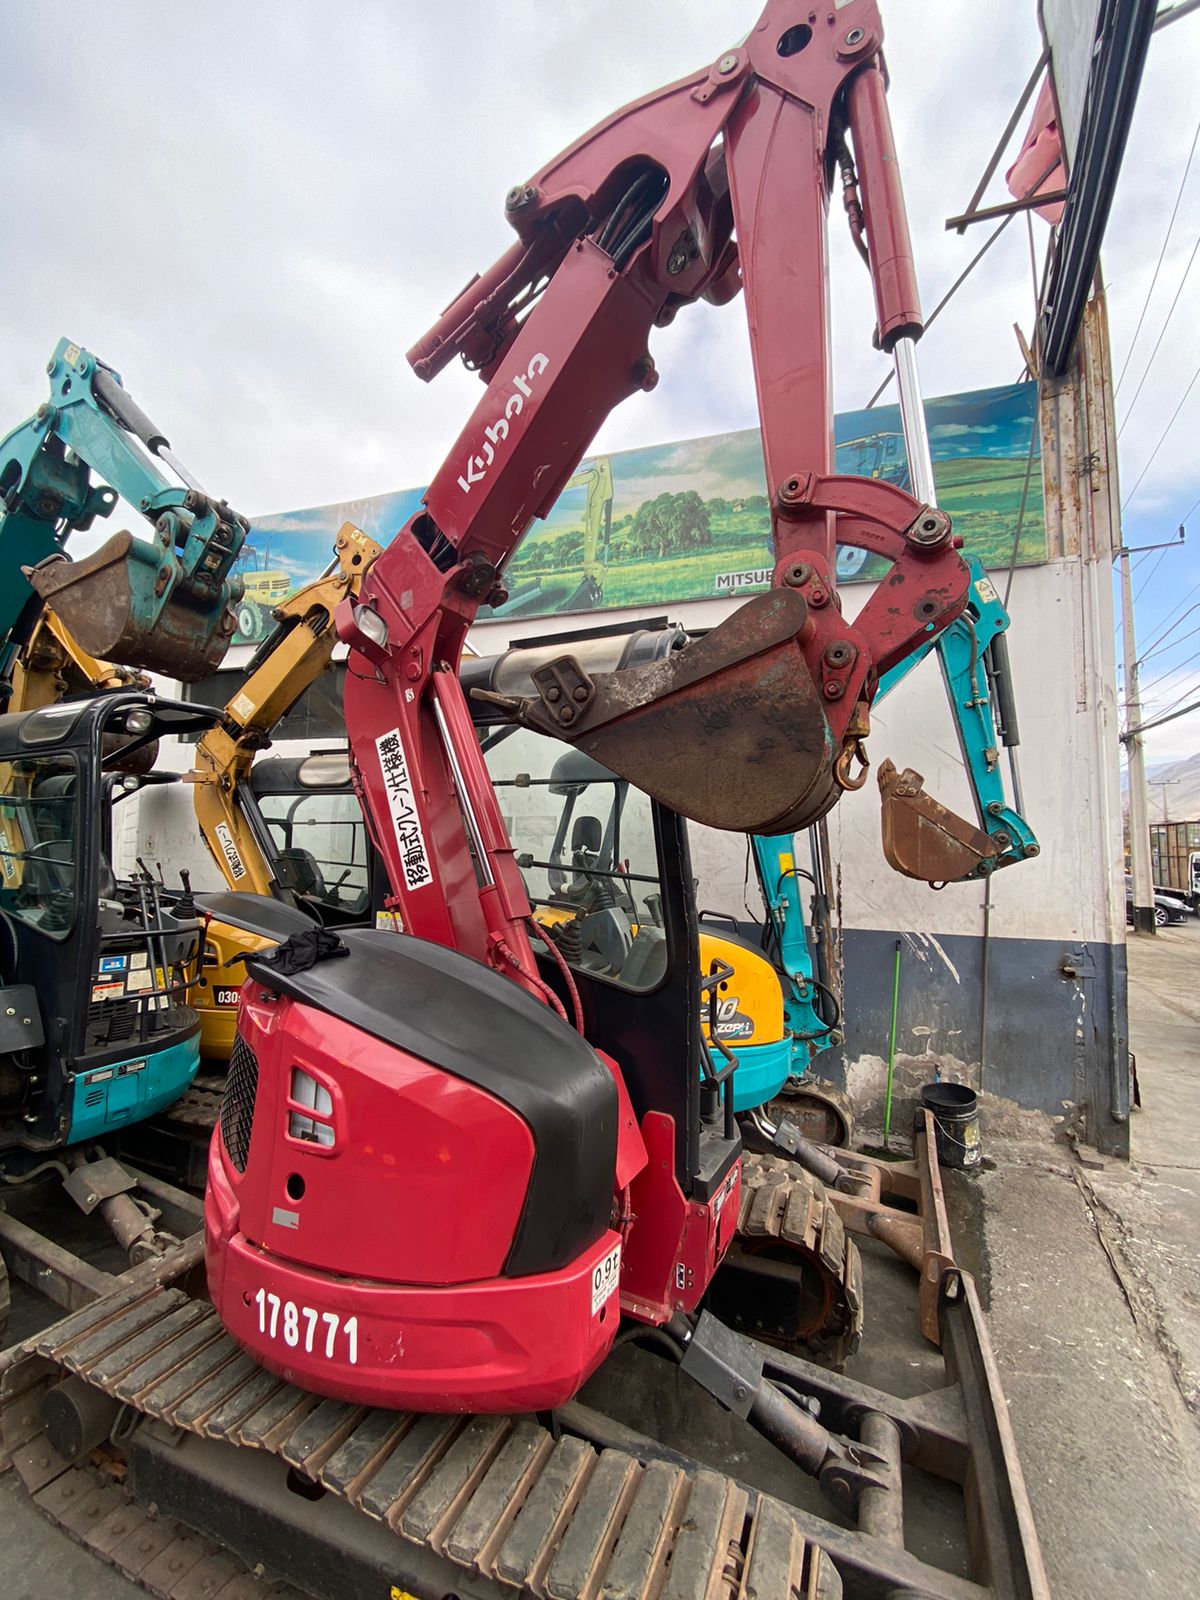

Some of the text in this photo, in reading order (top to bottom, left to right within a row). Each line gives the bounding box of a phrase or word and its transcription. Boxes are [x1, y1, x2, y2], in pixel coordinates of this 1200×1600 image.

[457, 352, 550, 493] Kubota
[379, 733, 430, 887] 移動式クレーン仕様機
[594, 1251, 619, 1291] 0.9t
[255, 1287, 358, 1365] 178771
